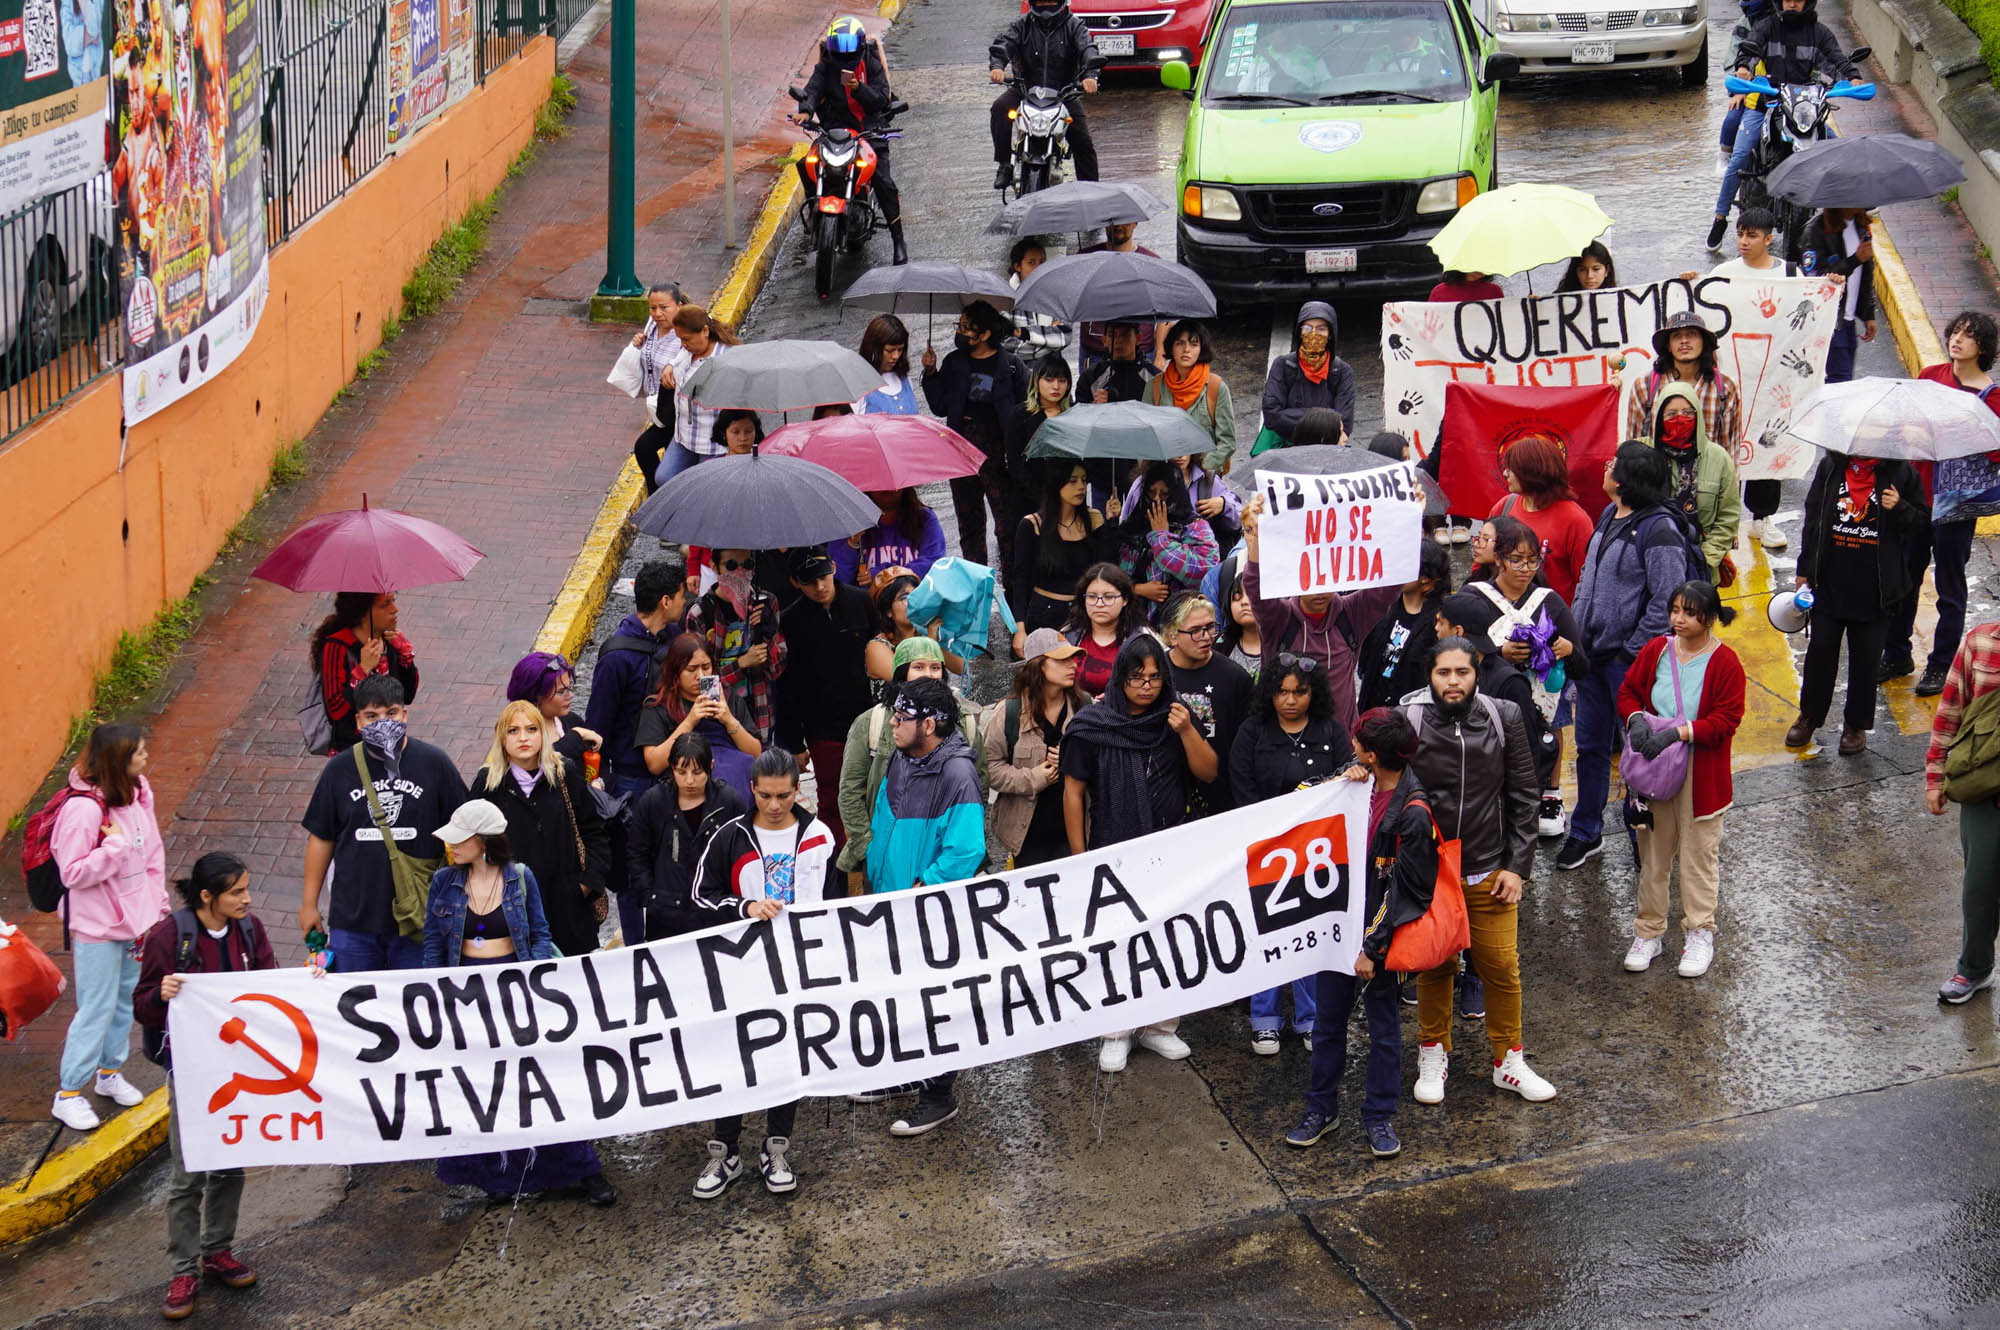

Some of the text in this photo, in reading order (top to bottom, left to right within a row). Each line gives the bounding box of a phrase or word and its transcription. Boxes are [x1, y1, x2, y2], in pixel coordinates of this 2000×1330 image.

[1574, 46, 1613, 57] YHC-979-B
[31, 110, 41, 127] tu
[43, 93, 79, 123] campus!
[1455, 277, 1732, 364] QUEREMOS
[1305, 505, 1372, 545] NO SE
[1842, 526, 1859, 535] and
[861, 544, 920, 569] ANSAS
[1299, 546, 1383, 592] OLVIDA
[393, 778, 424, 800] SIDE
[1260, 837, 1340, 917] 28
[338, 863, 1148, 1062] SOMOS LA MEMORIA
[360, 900, 1247, 1141] VIVA DEL PROLETARIADO
[221, 1111, 324, 1146] JCM
